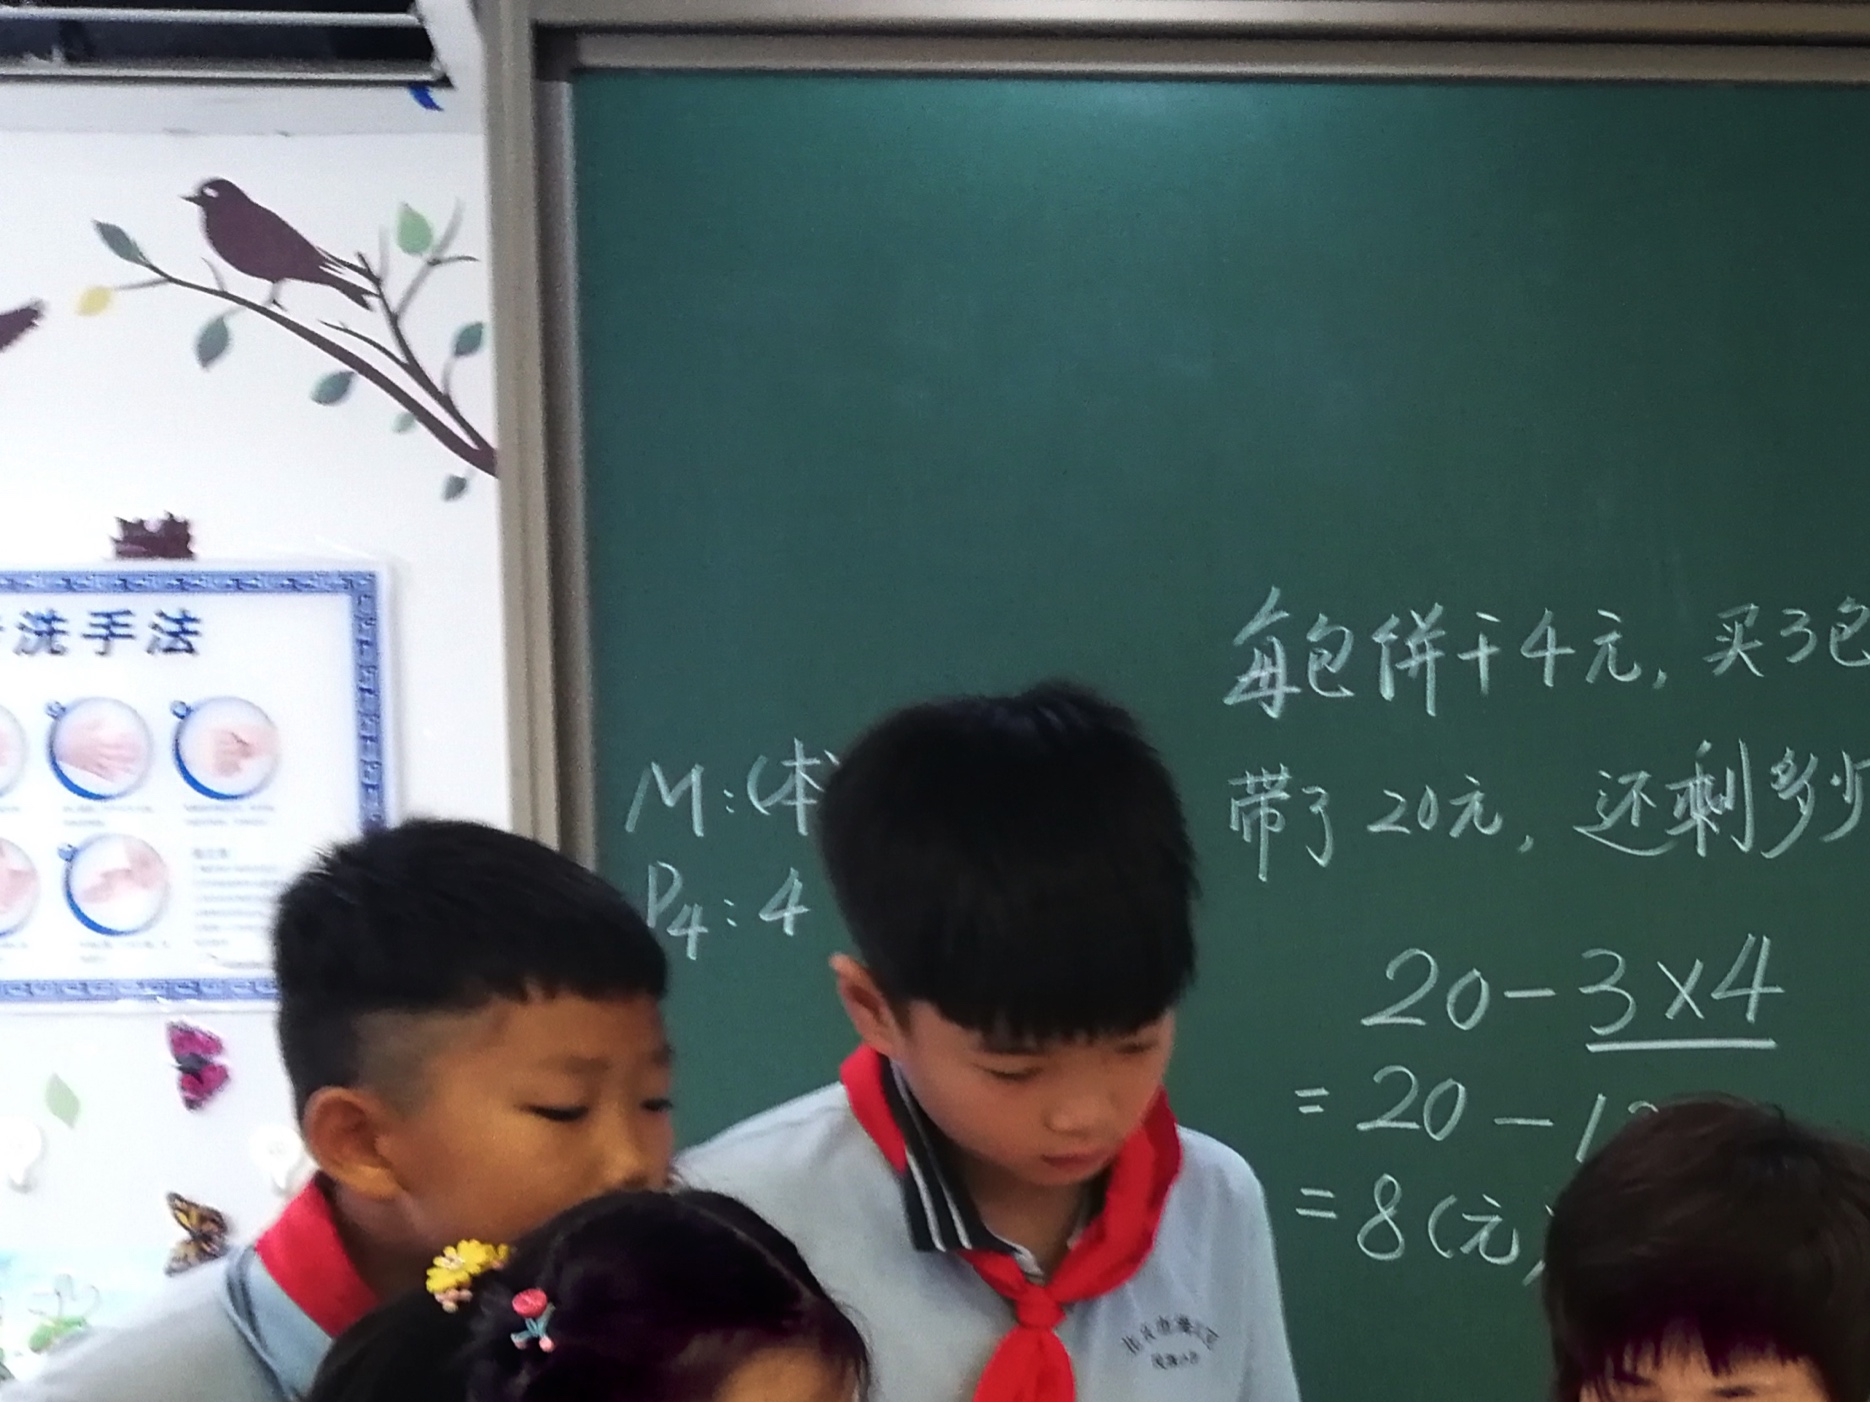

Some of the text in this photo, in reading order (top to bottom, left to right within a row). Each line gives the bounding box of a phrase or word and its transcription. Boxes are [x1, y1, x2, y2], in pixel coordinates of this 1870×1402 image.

[0, 608, 202, 656] 洗手法
[1294, 1064, 1660, 1163] =20-1
[1295, 1173, 1555, 1287] =8(元
